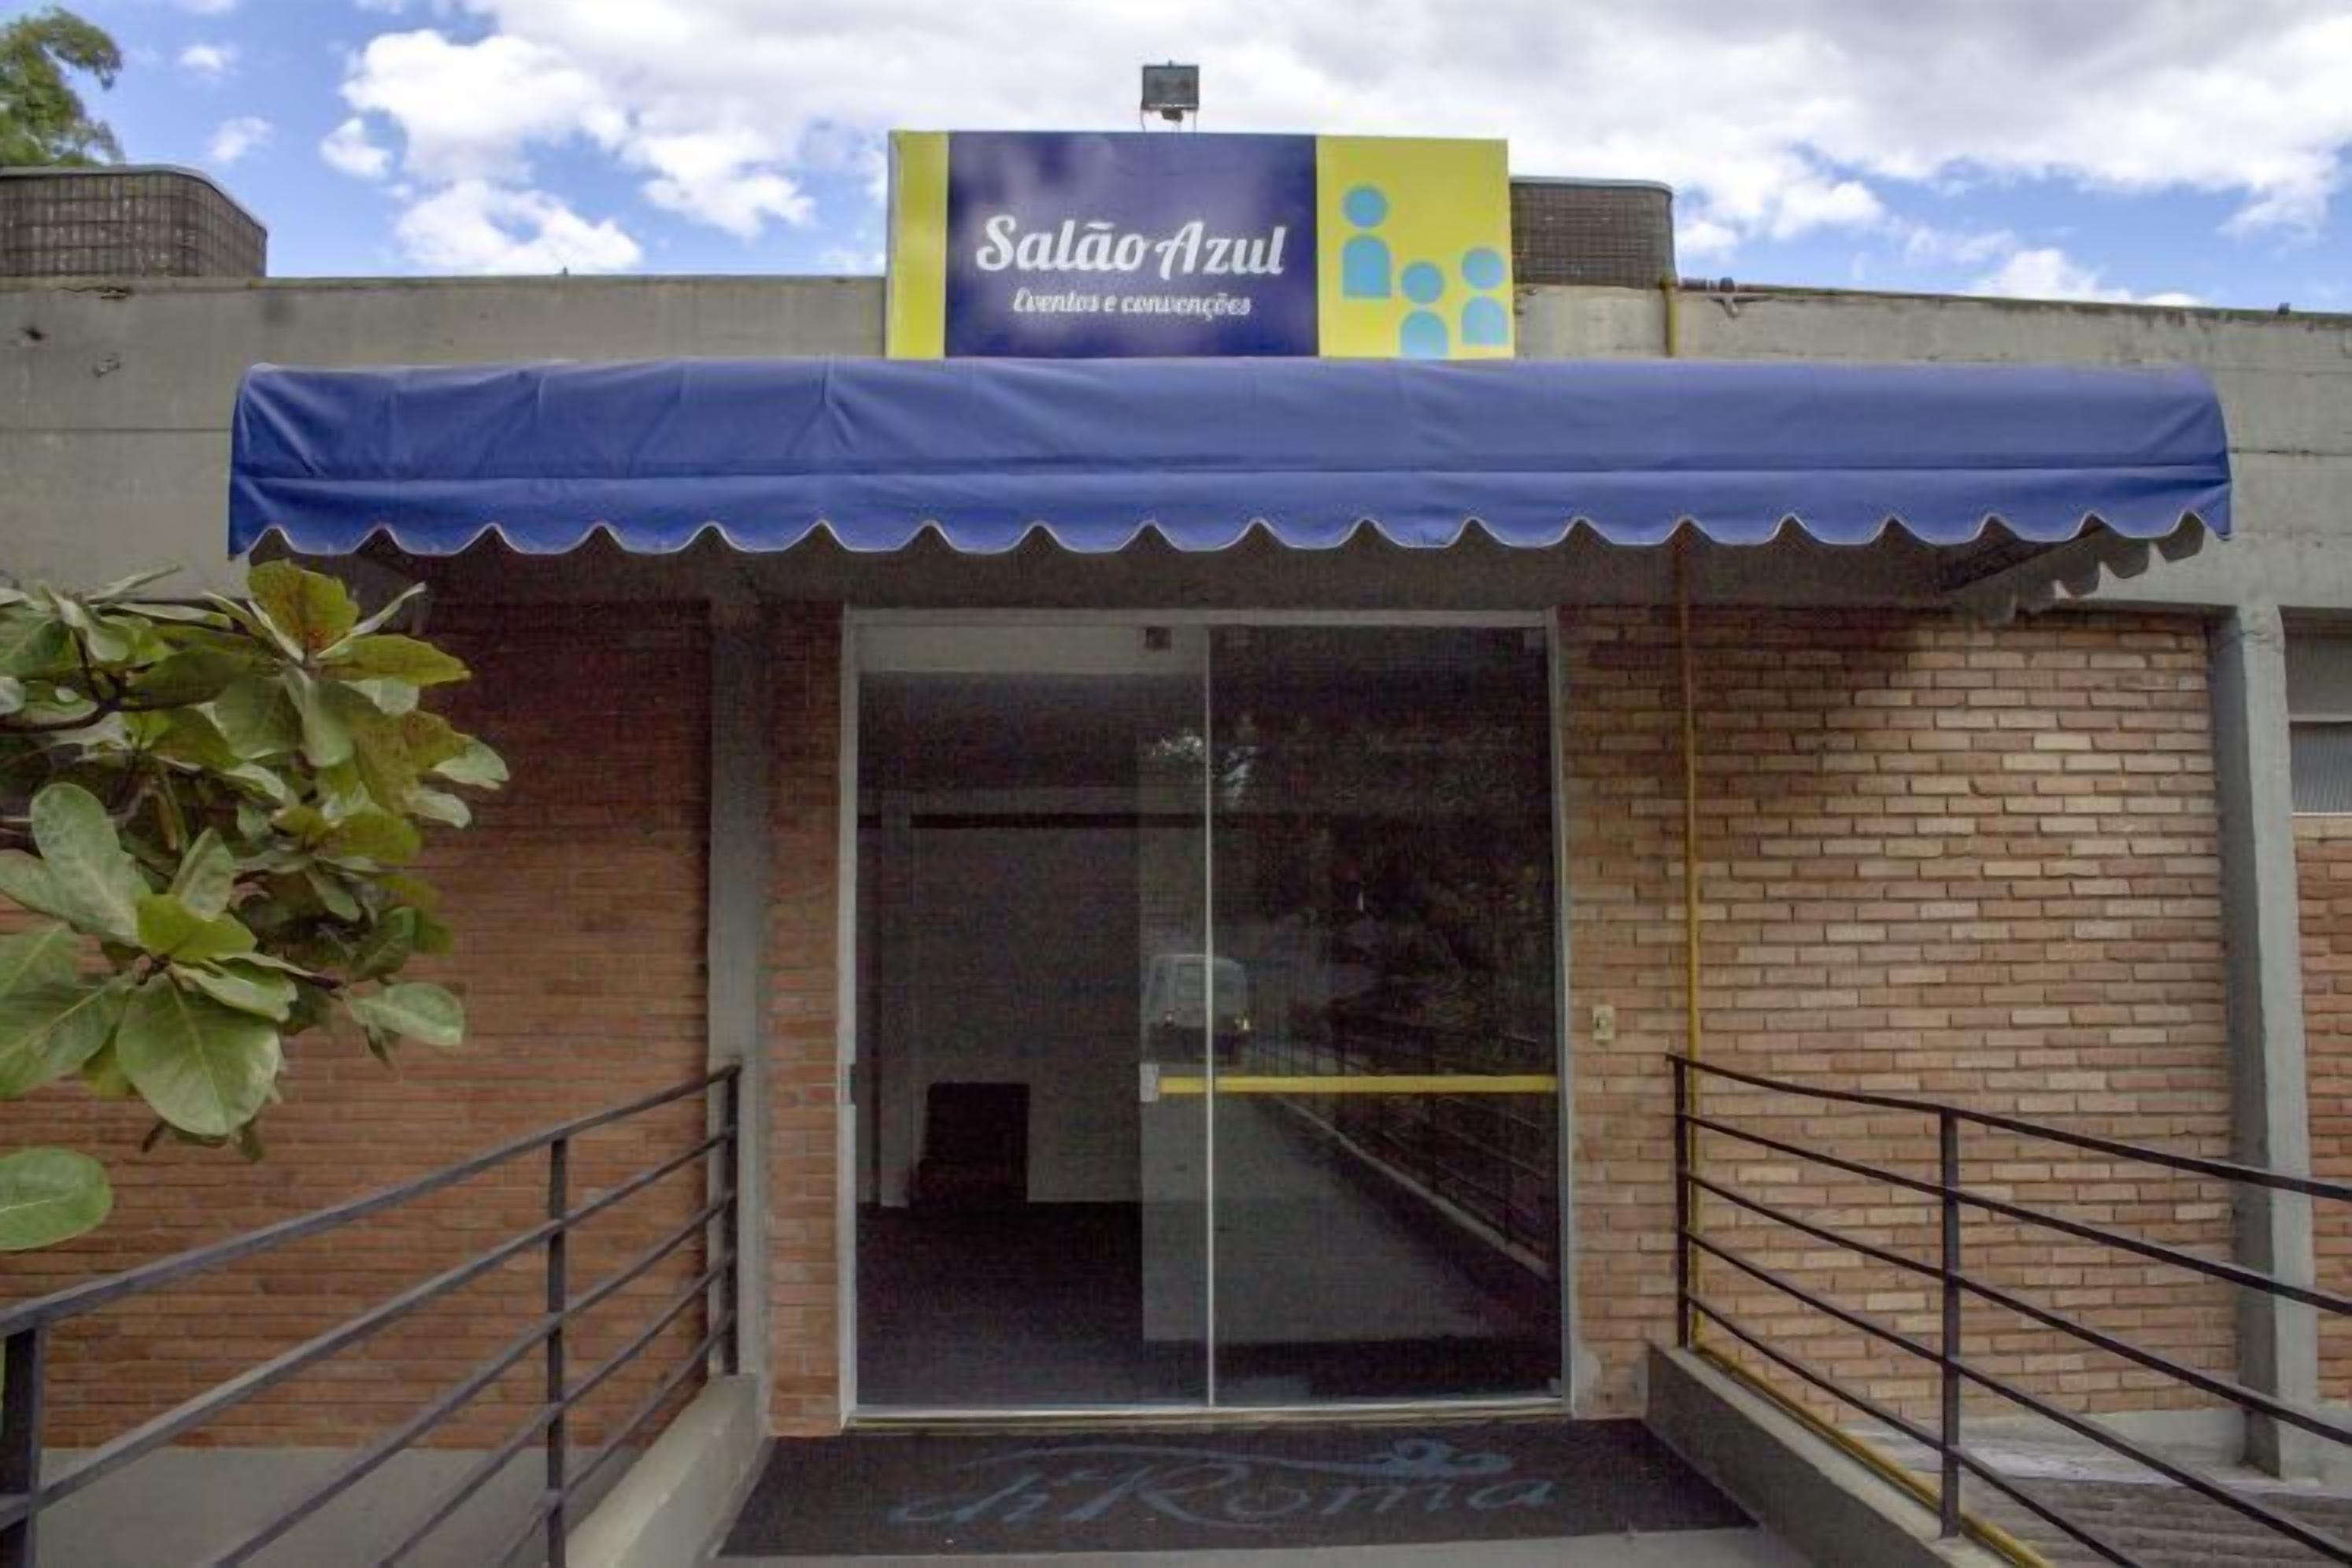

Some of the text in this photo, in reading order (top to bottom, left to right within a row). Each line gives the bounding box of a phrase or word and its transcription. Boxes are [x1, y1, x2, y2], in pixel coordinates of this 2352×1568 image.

[975, 214, 1287, 280] Salão Azul
[1012, 287, 1252, 321] Eventos e convenções
